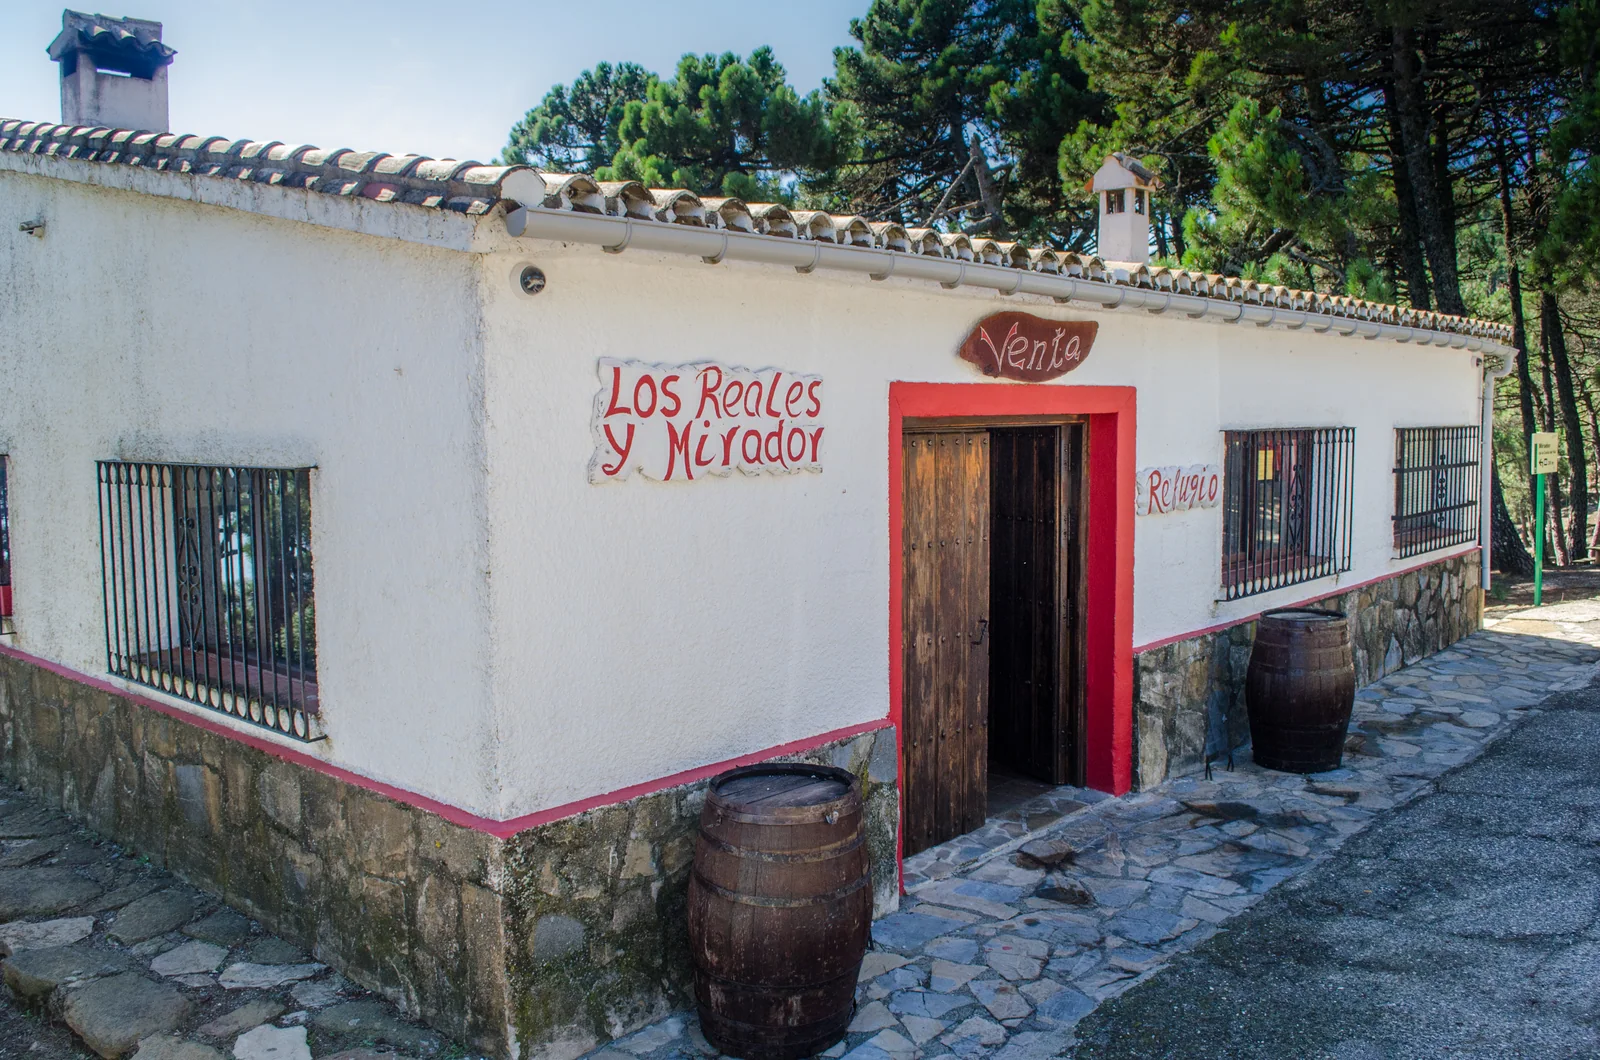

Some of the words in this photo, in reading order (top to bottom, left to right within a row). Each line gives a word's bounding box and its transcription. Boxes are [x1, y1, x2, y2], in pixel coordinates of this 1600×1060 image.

[979, 321, 1081, 372] Venta
[695, 365, 822, 419] Reales
[663, 419, 825, 481] Mirador
[1147, 467, 1218, 515] Refugio
